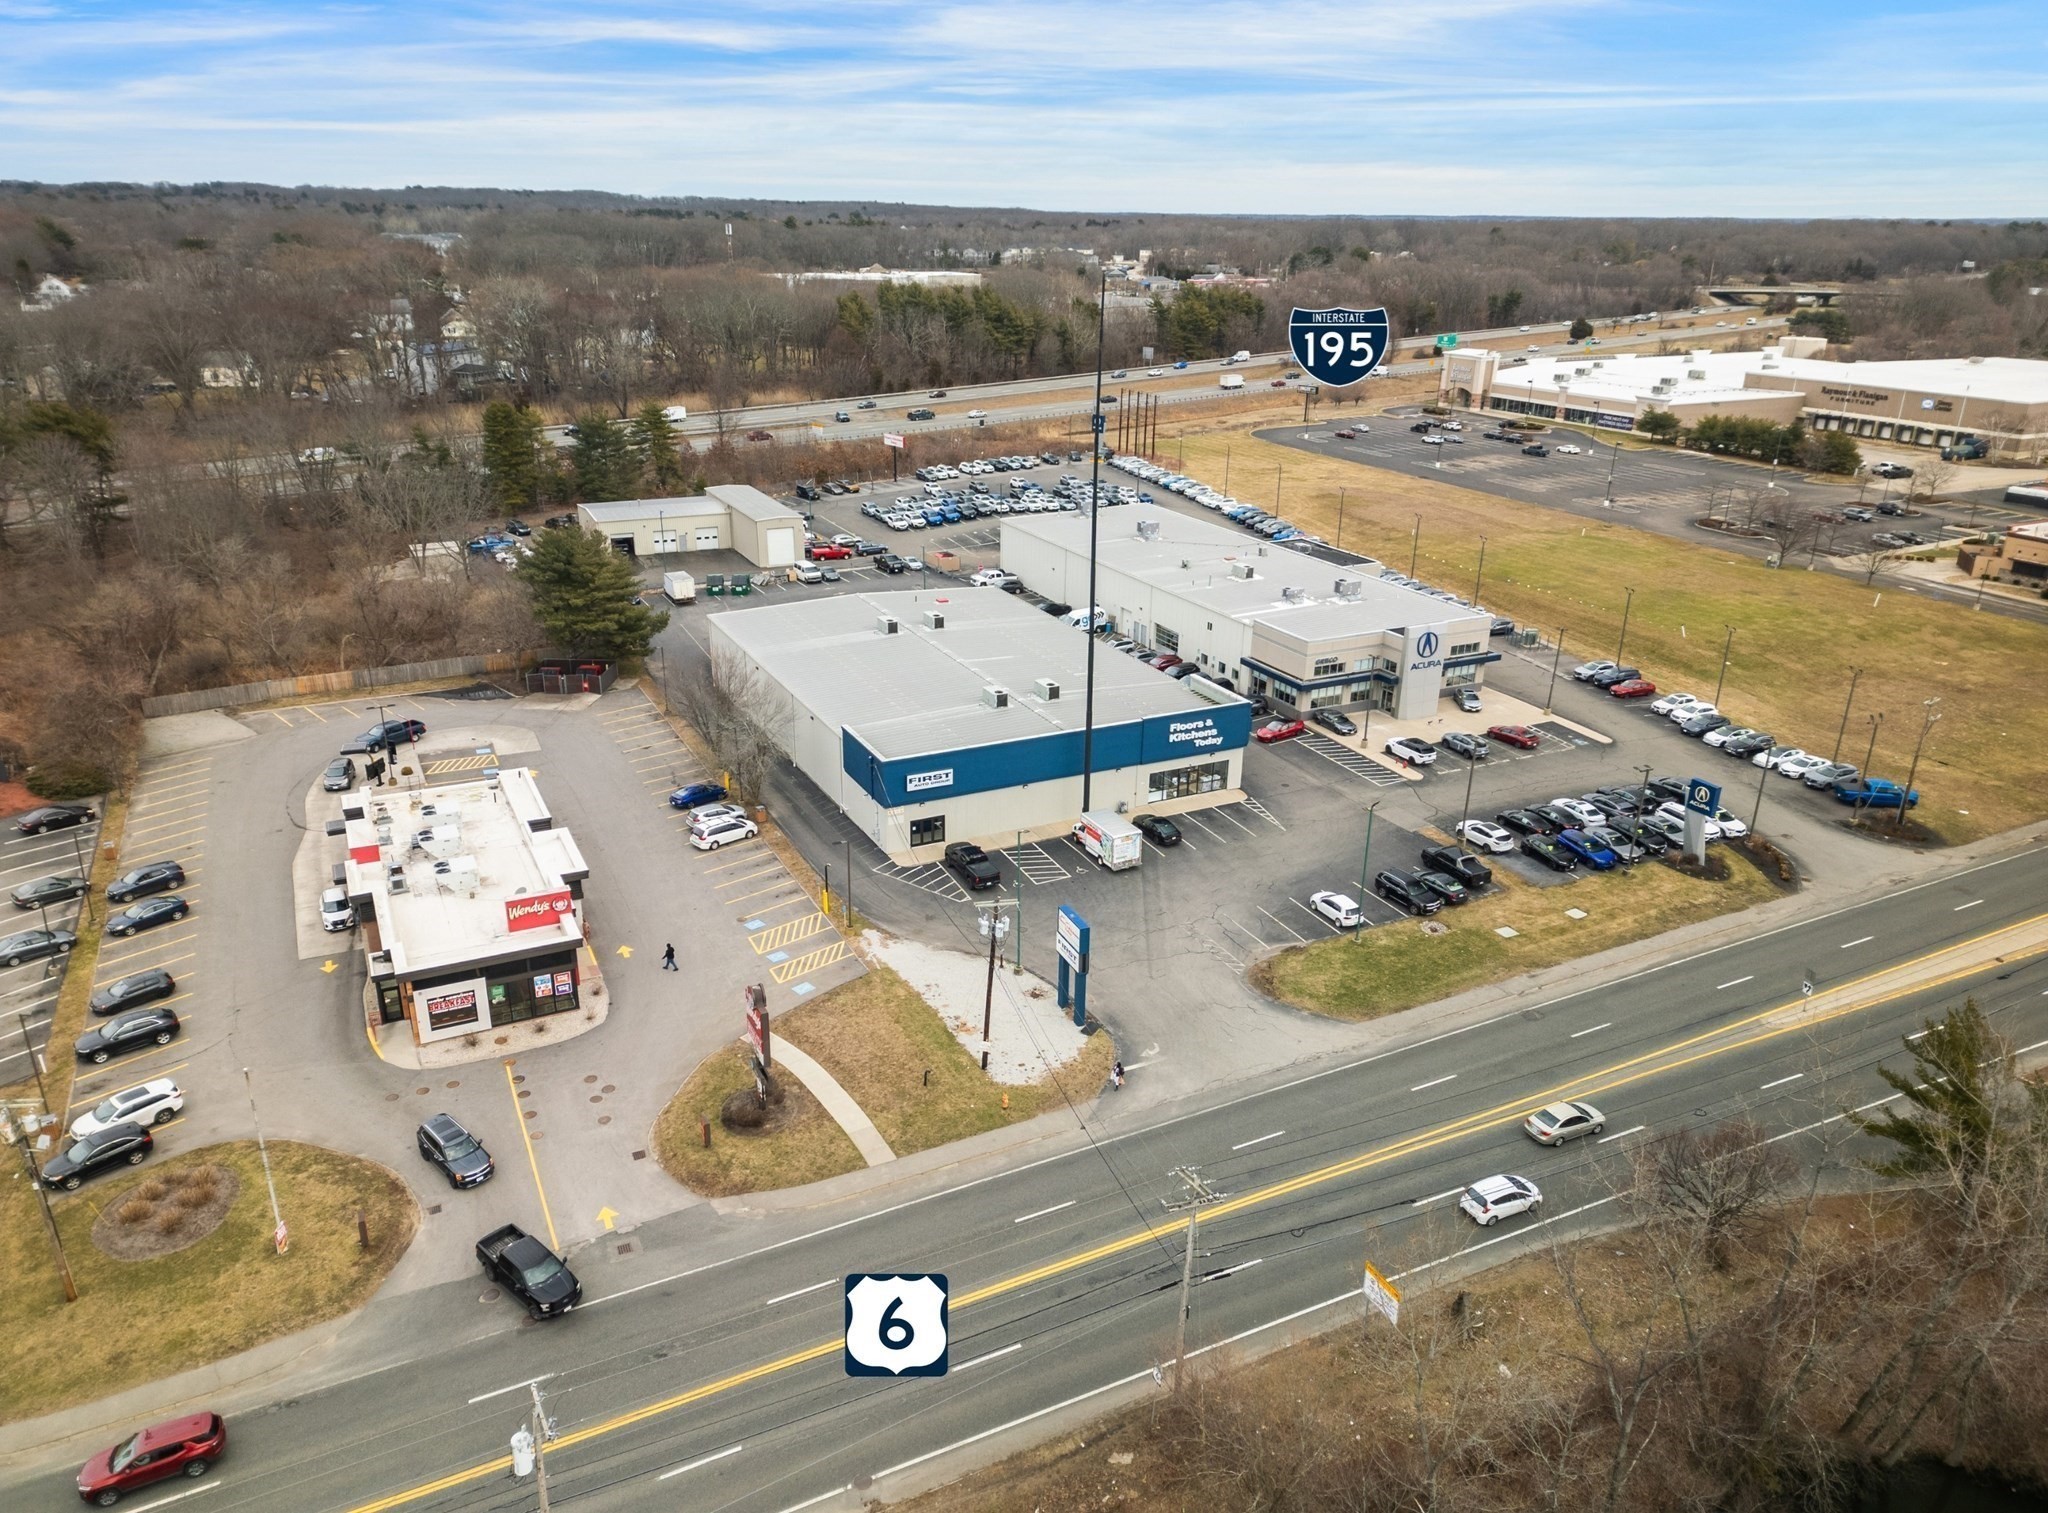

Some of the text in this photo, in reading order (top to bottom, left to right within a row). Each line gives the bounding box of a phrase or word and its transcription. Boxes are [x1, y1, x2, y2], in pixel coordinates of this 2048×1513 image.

[1858, 389, 1888, 401] Flanigan
[1411, 660, 1441, 670] ACURA
[1169, 718, 1213, 732] Floors &
[1169, 728, 1218, 742] Kitchens
[1193, 736, 1223, 747] Today
[908, 772, 951, 784] FIRST
[1689, 800, 1710, 811] ACURA
[508, 900, 550, 920] Wendy's
[428, 994, 475, 1012] BREAKFAST
